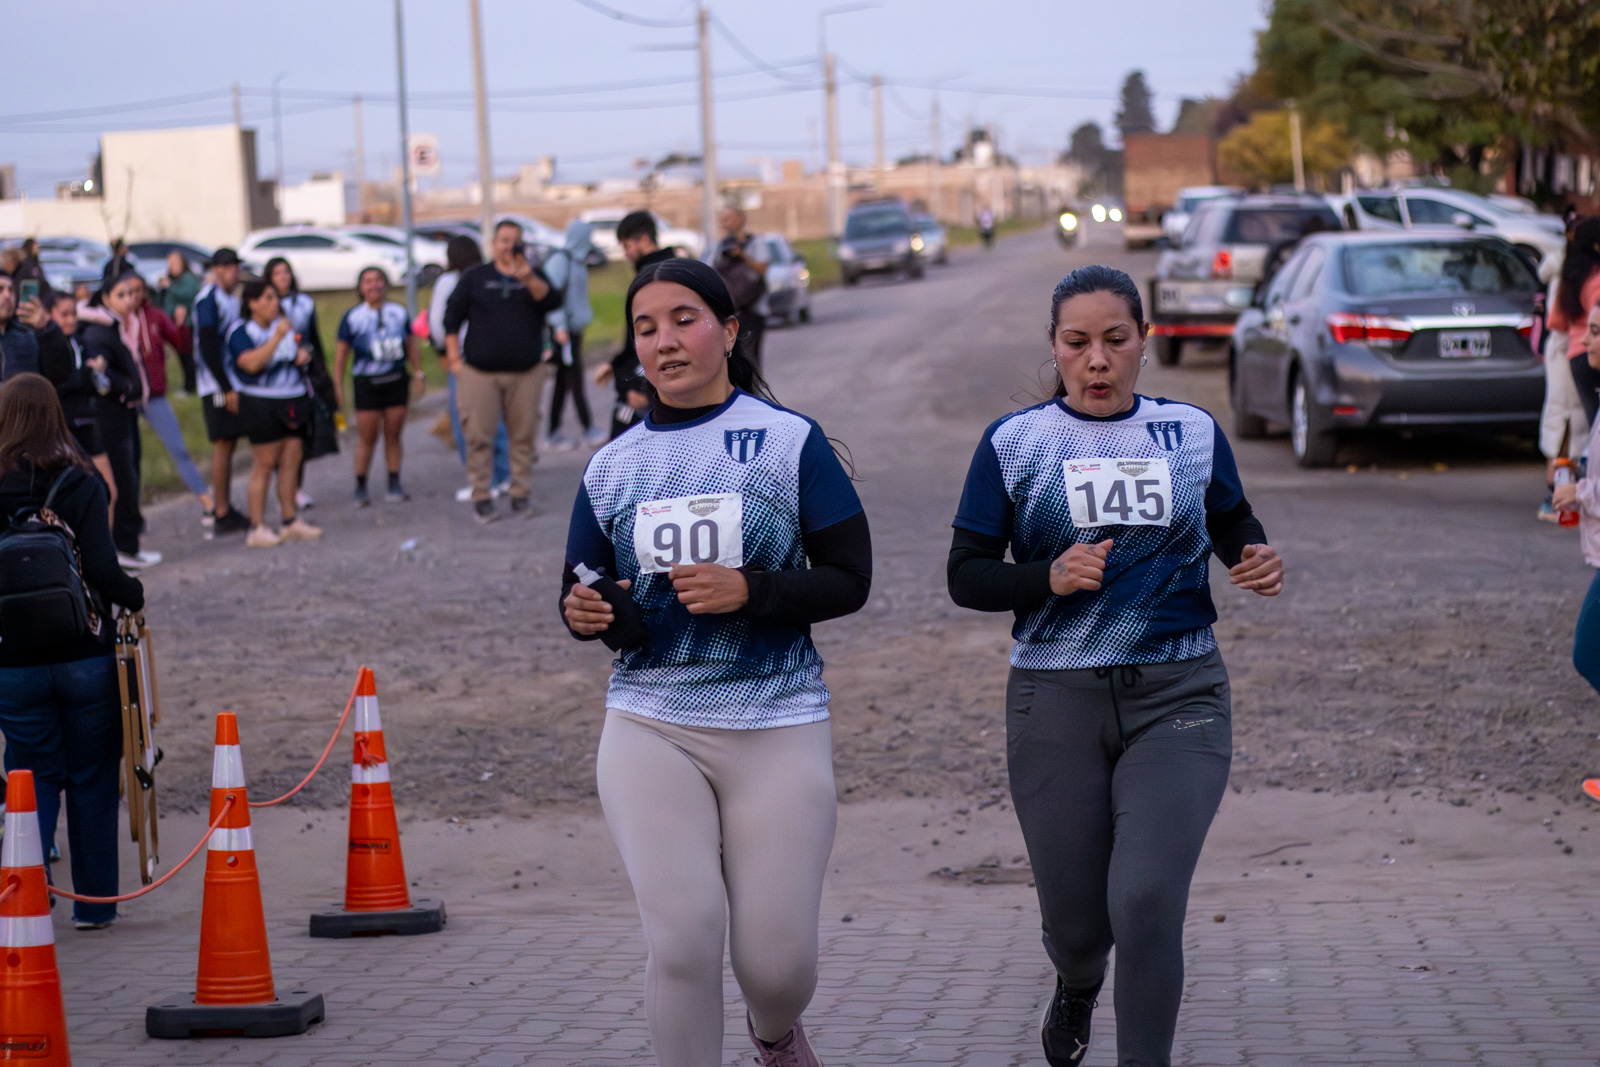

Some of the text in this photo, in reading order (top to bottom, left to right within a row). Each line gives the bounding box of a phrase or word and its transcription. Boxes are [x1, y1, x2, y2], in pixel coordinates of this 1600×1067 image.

[731, 431, 759, 440] SFC
[1153, 422, 1175, 431] SFC
[1075, 479, 1165, 523] 145
[653, 519, 719, 568] 90
